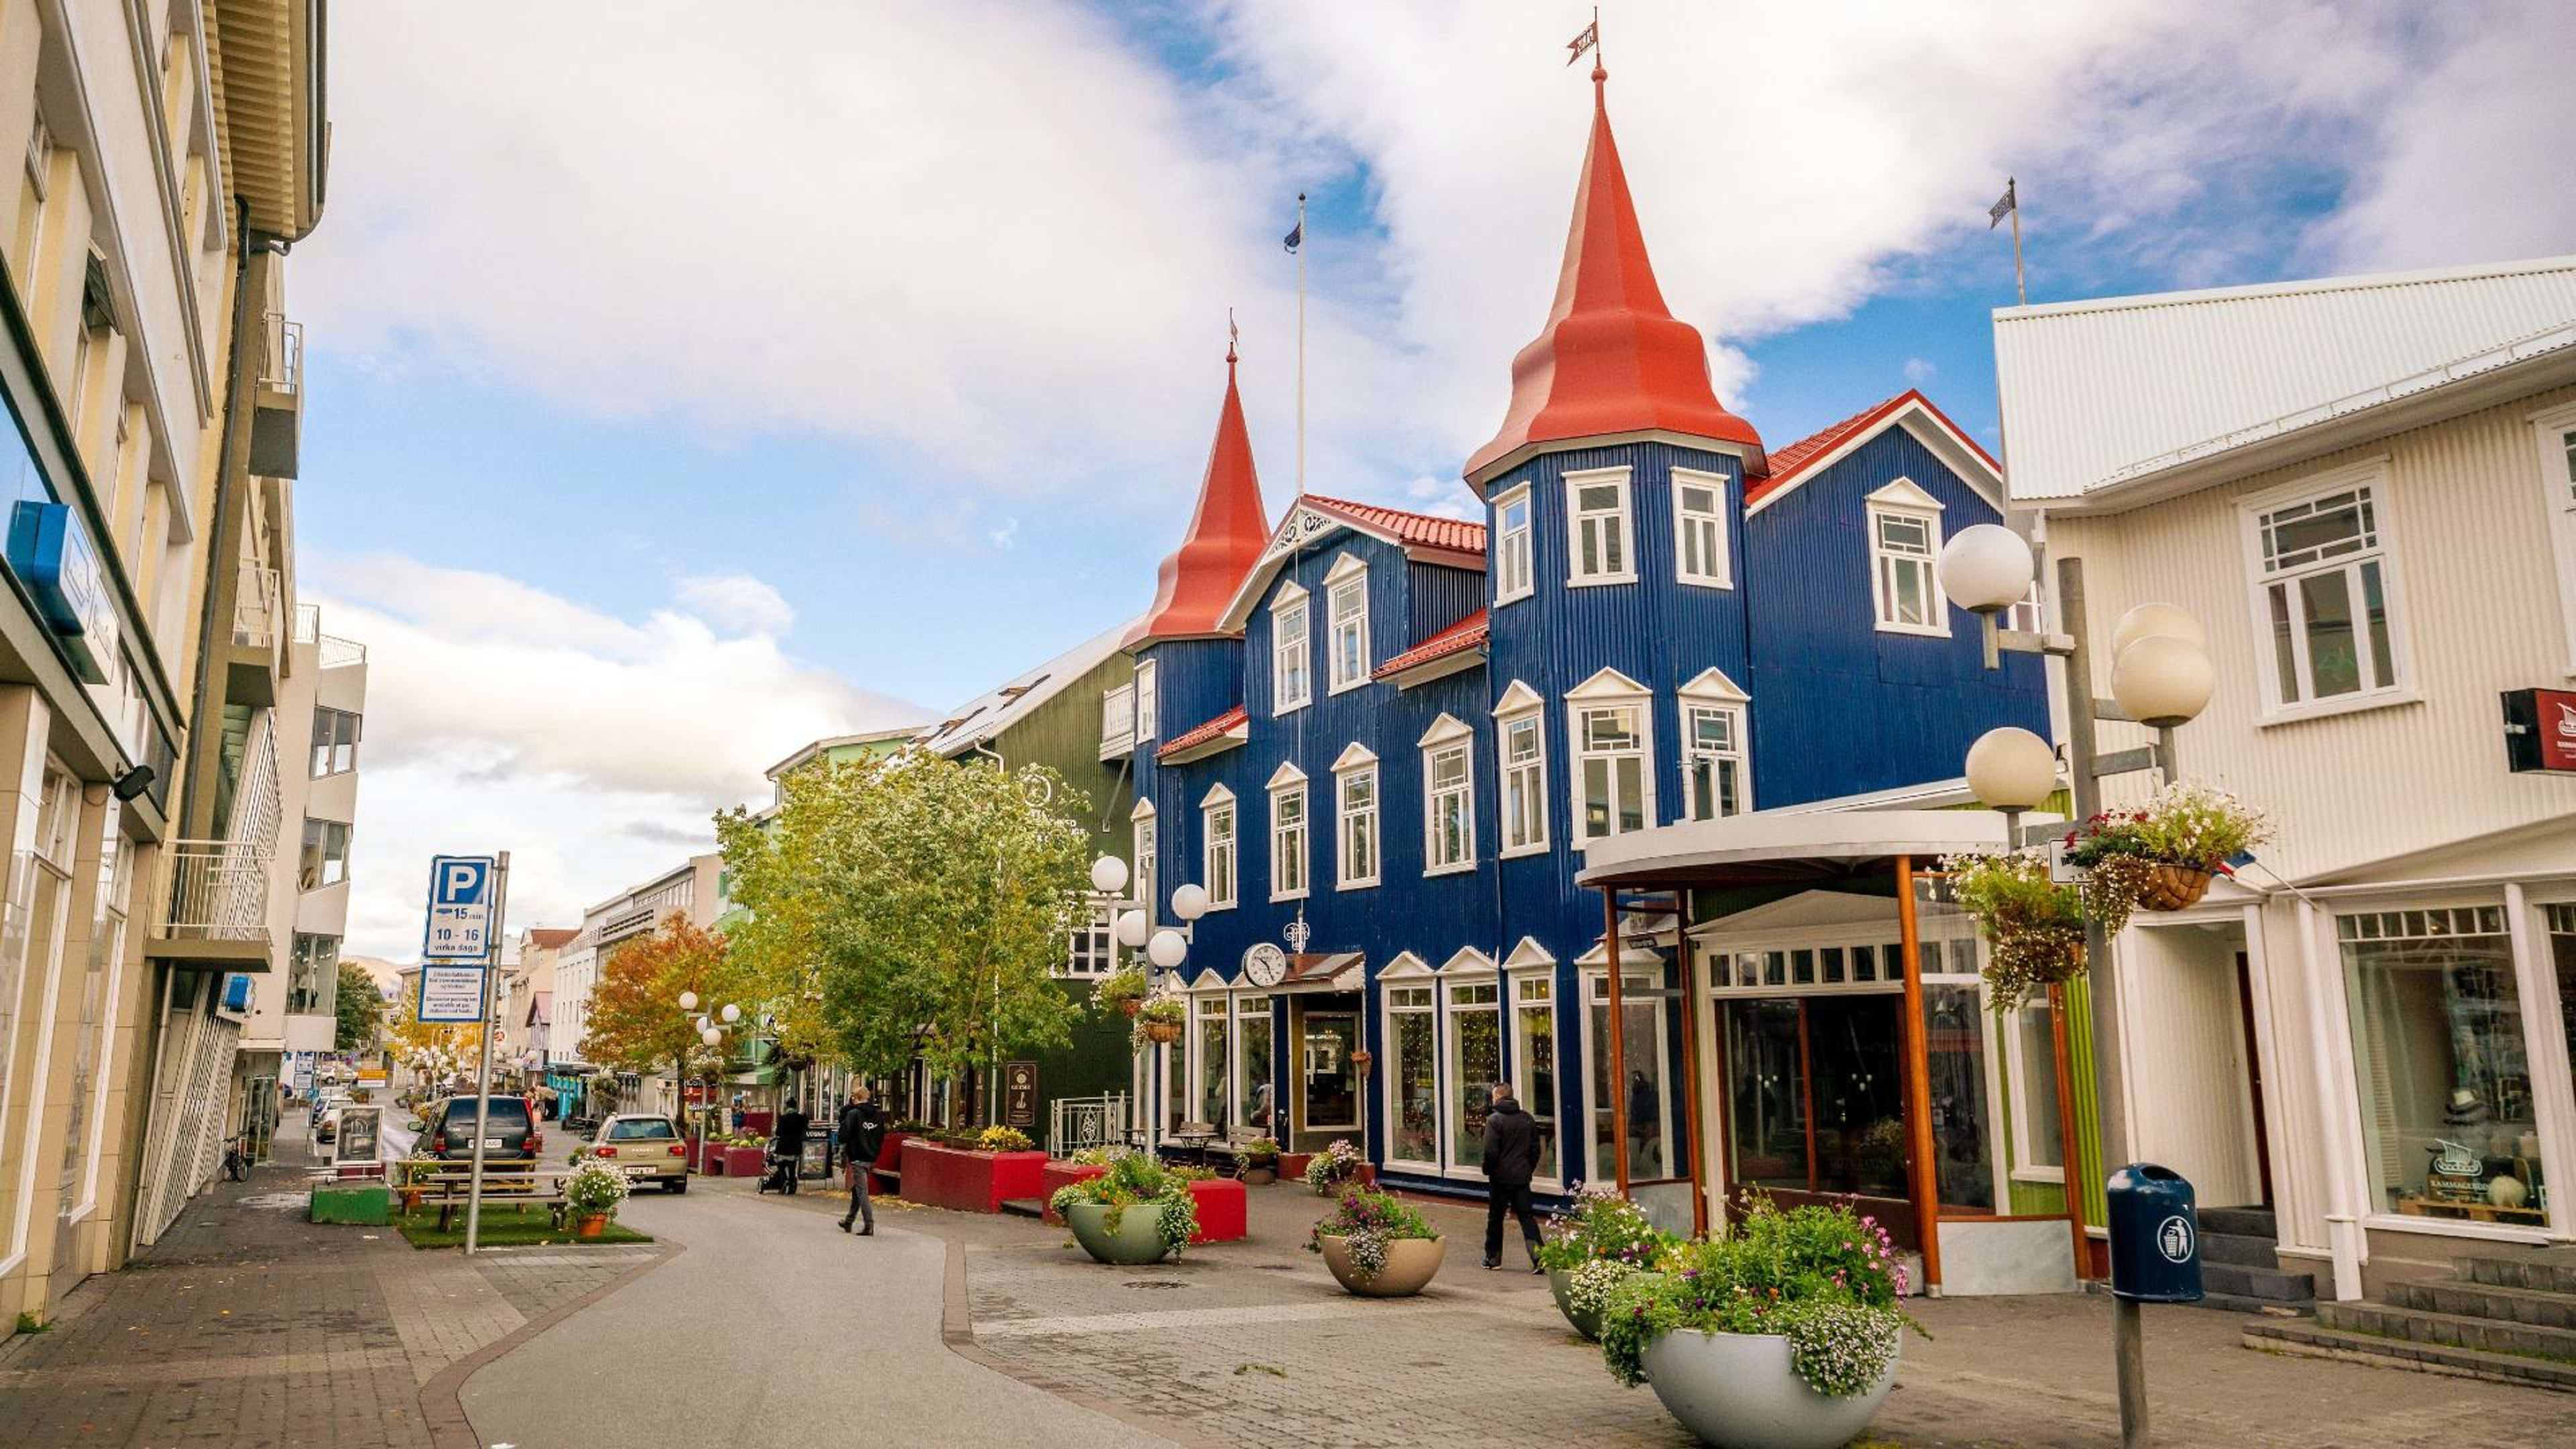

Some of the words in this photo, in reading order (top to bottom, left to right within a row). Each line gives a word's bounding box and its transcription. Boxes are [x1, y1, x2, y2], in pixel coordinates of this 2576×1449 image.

[446, 865, 477, 901] P
[454, 908, 468, 920] 15
[437, 928, 451, 940] 10
[465, 929, 478, 941] 16
